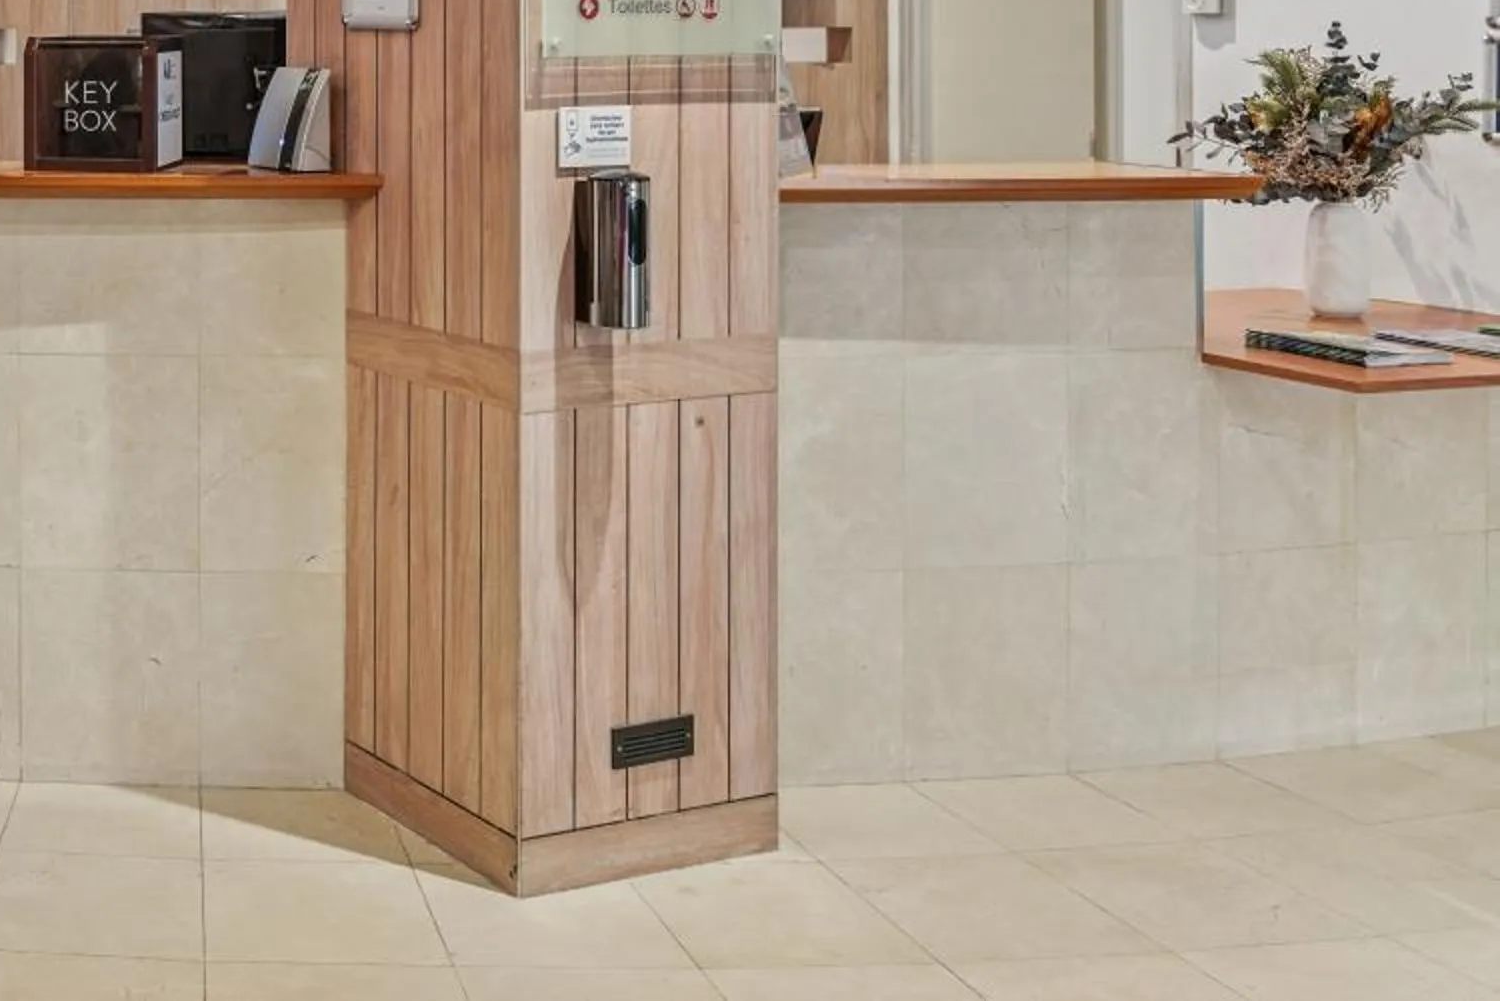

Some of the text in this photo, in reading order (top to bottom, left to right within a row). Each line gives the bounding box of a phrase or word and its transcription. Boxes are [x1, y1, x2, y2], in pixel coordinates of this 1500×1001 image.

[608, 0, 671, 15] Toilettes
[65, 80, 118, 104] KEY
[64, 109, 117, 132] BOX
